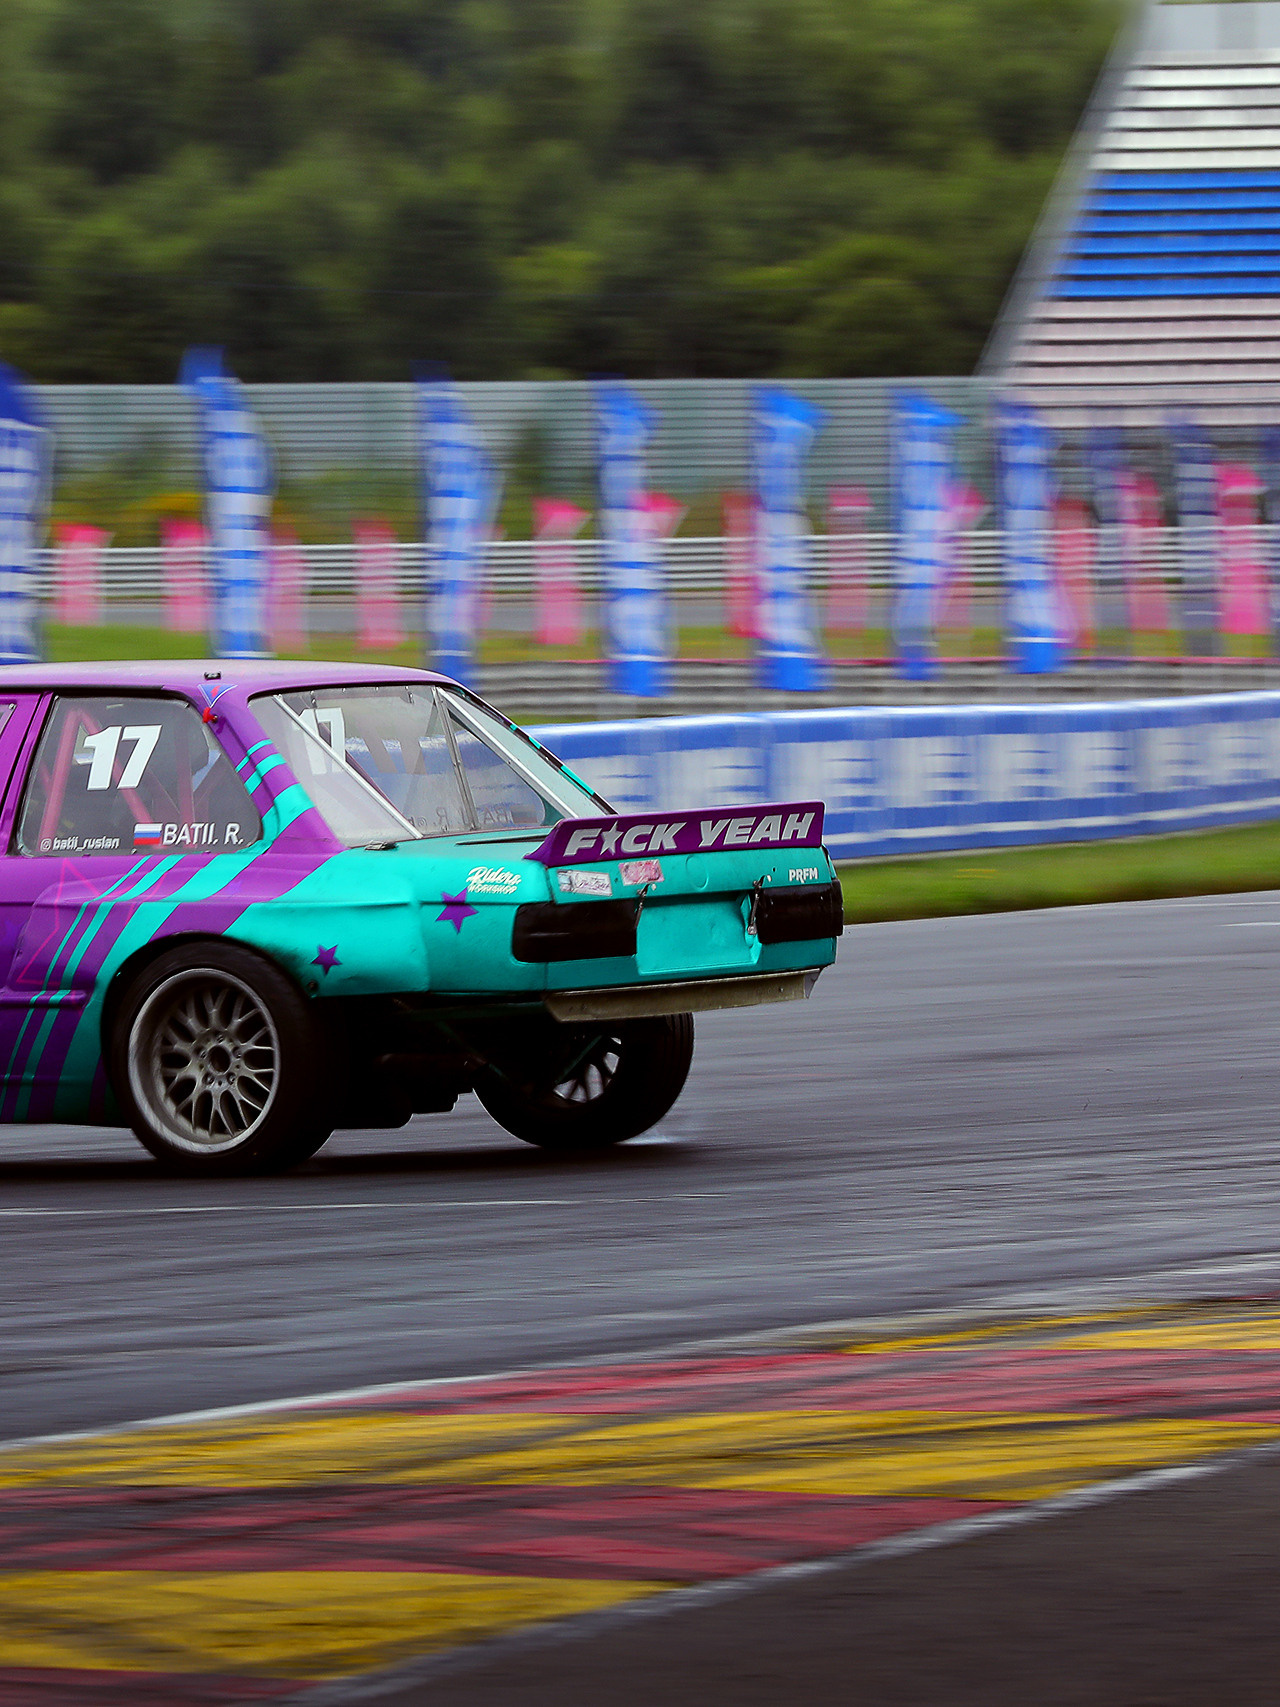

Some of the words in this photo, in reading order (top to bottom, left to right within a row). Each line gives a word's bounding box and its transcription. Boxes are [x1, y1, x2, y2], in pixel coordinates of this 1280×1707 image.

[83, 725, 162, 790] 17
[224, 822, 245, 845] R.
[699, 812, 816, 848] YEAH
[788, 867, 818, 884] PRFM
